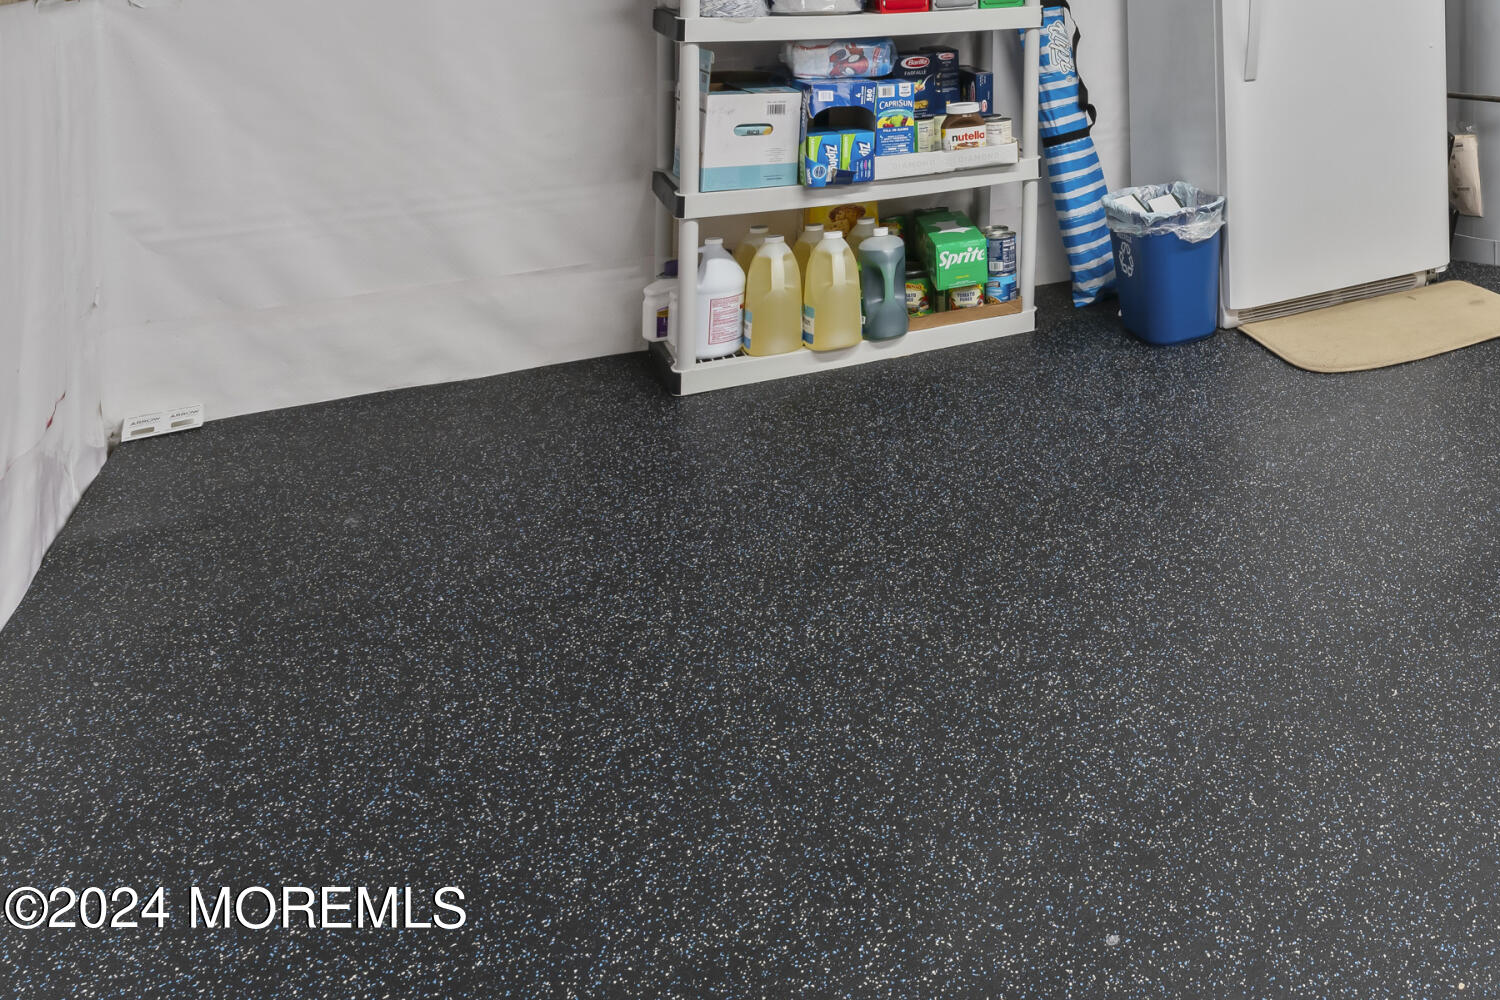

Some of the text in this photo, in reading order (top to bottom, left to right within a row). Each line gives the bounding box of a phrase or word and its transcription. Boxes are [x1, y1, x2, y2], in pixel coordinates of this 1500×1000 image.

[907, 58, 929, 67] Barilla
[951, 130, 985, 142] nutella
[939, 246, 985, 270] Sprite
